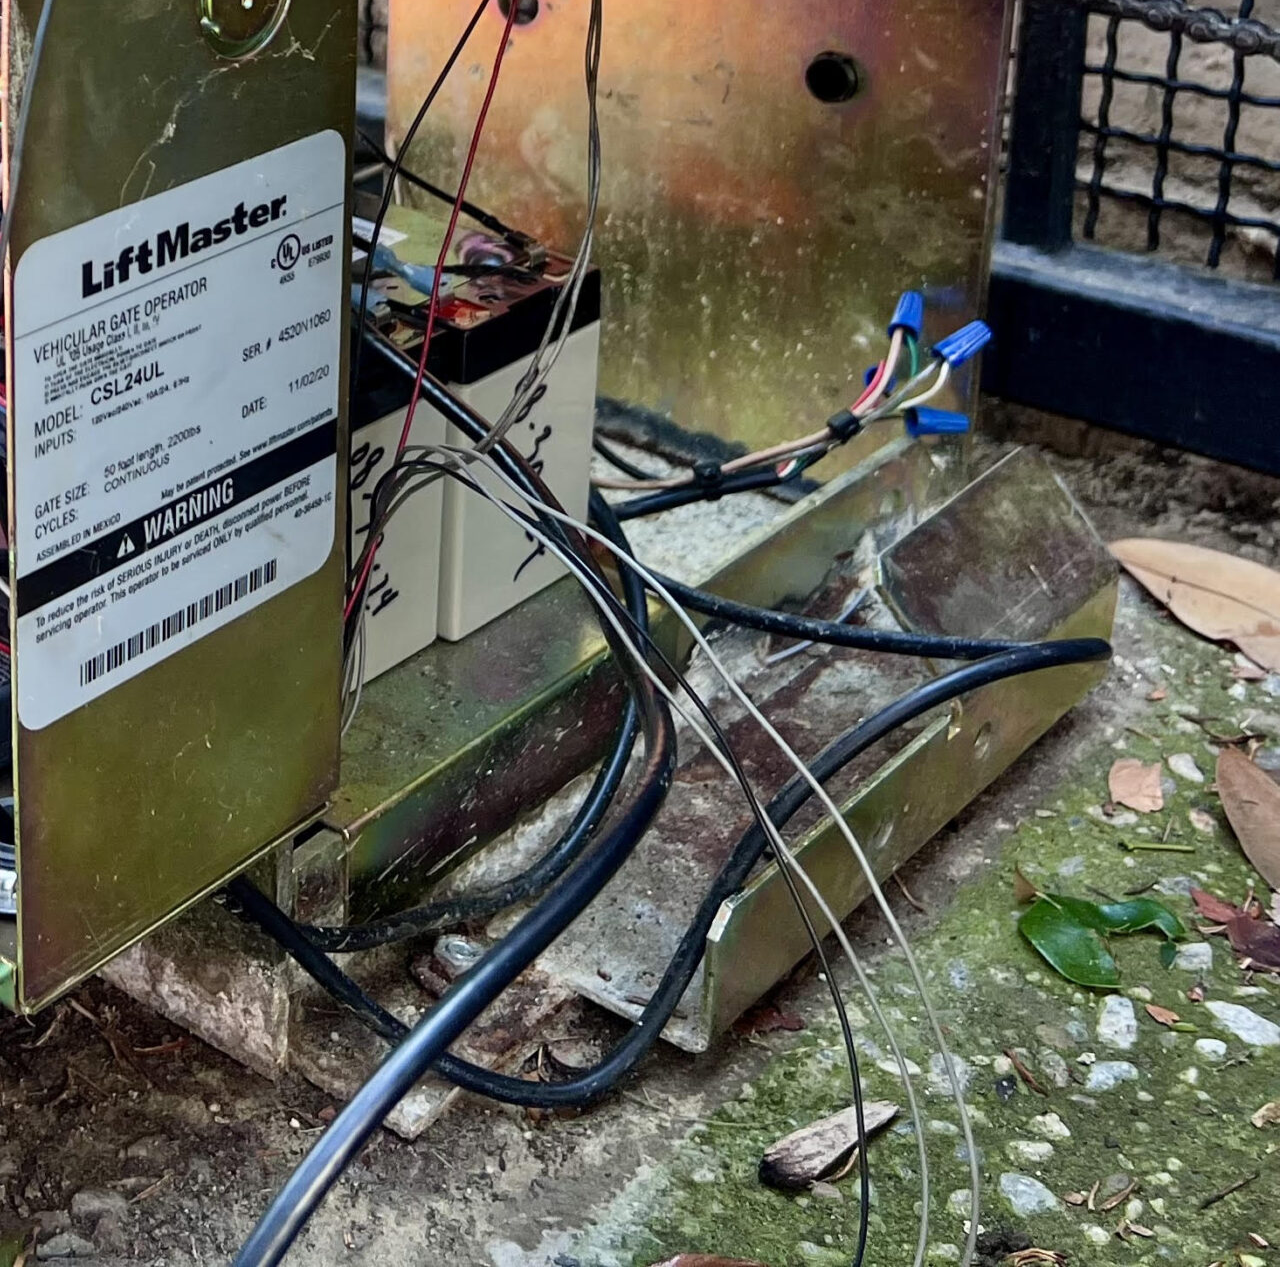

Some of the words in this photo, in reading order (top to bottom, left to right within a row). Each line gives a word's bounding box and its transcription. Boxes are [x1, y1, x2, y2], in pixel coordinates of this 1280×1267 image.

[33, 318, 106, 365] VEHICULAR
[110, 303, 140, 332] GATE
[144, 275, 206, 318] OPERATOR
[106, 327, 125, 347] Class
[242, 339, 263, 362] SER.
[34, 401, 82, 439] MODEL:
[90, 356, 164, 407] CSL24UL
[241, 394, 267, 419] DATE:
[288, 363, 329, 395] 11/02/20
[34, 426, 76, 460] INPUTS:
[34, 493, 61, 520] GATE
[64, 479, 90, 506] SIZE:
[103, 461, 115, 479] 50
[117, 452, 134, 473] foot
[135, 438, 165, 467] length,
[167, 421, 200, 449] 2200lbs
[35, 505, 78, 541] CYCLES:
[103, 451, 170, 495] CONTINUOUS
[36, 531, 81, 563] ASSEMBLED
[83, 526, 90, 540] IN
[92, 512, 120, 535] MEXICO
[161, 485, 174, 502] May
[176, 480, 184, 493] be
[185, 470, 205, 489] patent
[239, 447, 250, 461] See
[143, 475, 234, 546] WARNING
[35, 615, 72, 646] servicing
[110, 585, 125, 604] This
[128, 569, 159, 596] operator
[161, 563, 169, 577] to
[170, 557, 178, 572] be
[181, 540, 211, 566] serviced
[213, 529, 233, 549] ONLY
[234, 523, 242, 539] by
[244, 506, 273, 533] qualified
[36, 613, 45, 629] To
[47, 598, 74, 623] reduce
[76, 591, 88, 608] the
[90, 583, 104, 600] risk
[107, 577, 115, 591] of
[116, 557, 152, 587] SERIOUS
[154, 542, 182, 567] INJURY
[194, 521, 220, 546] DEATH,
[222, 501, 259, 531] disconnect
[261, 491, 282, 511] power
[283, 473, 310, 498] BEFORE
